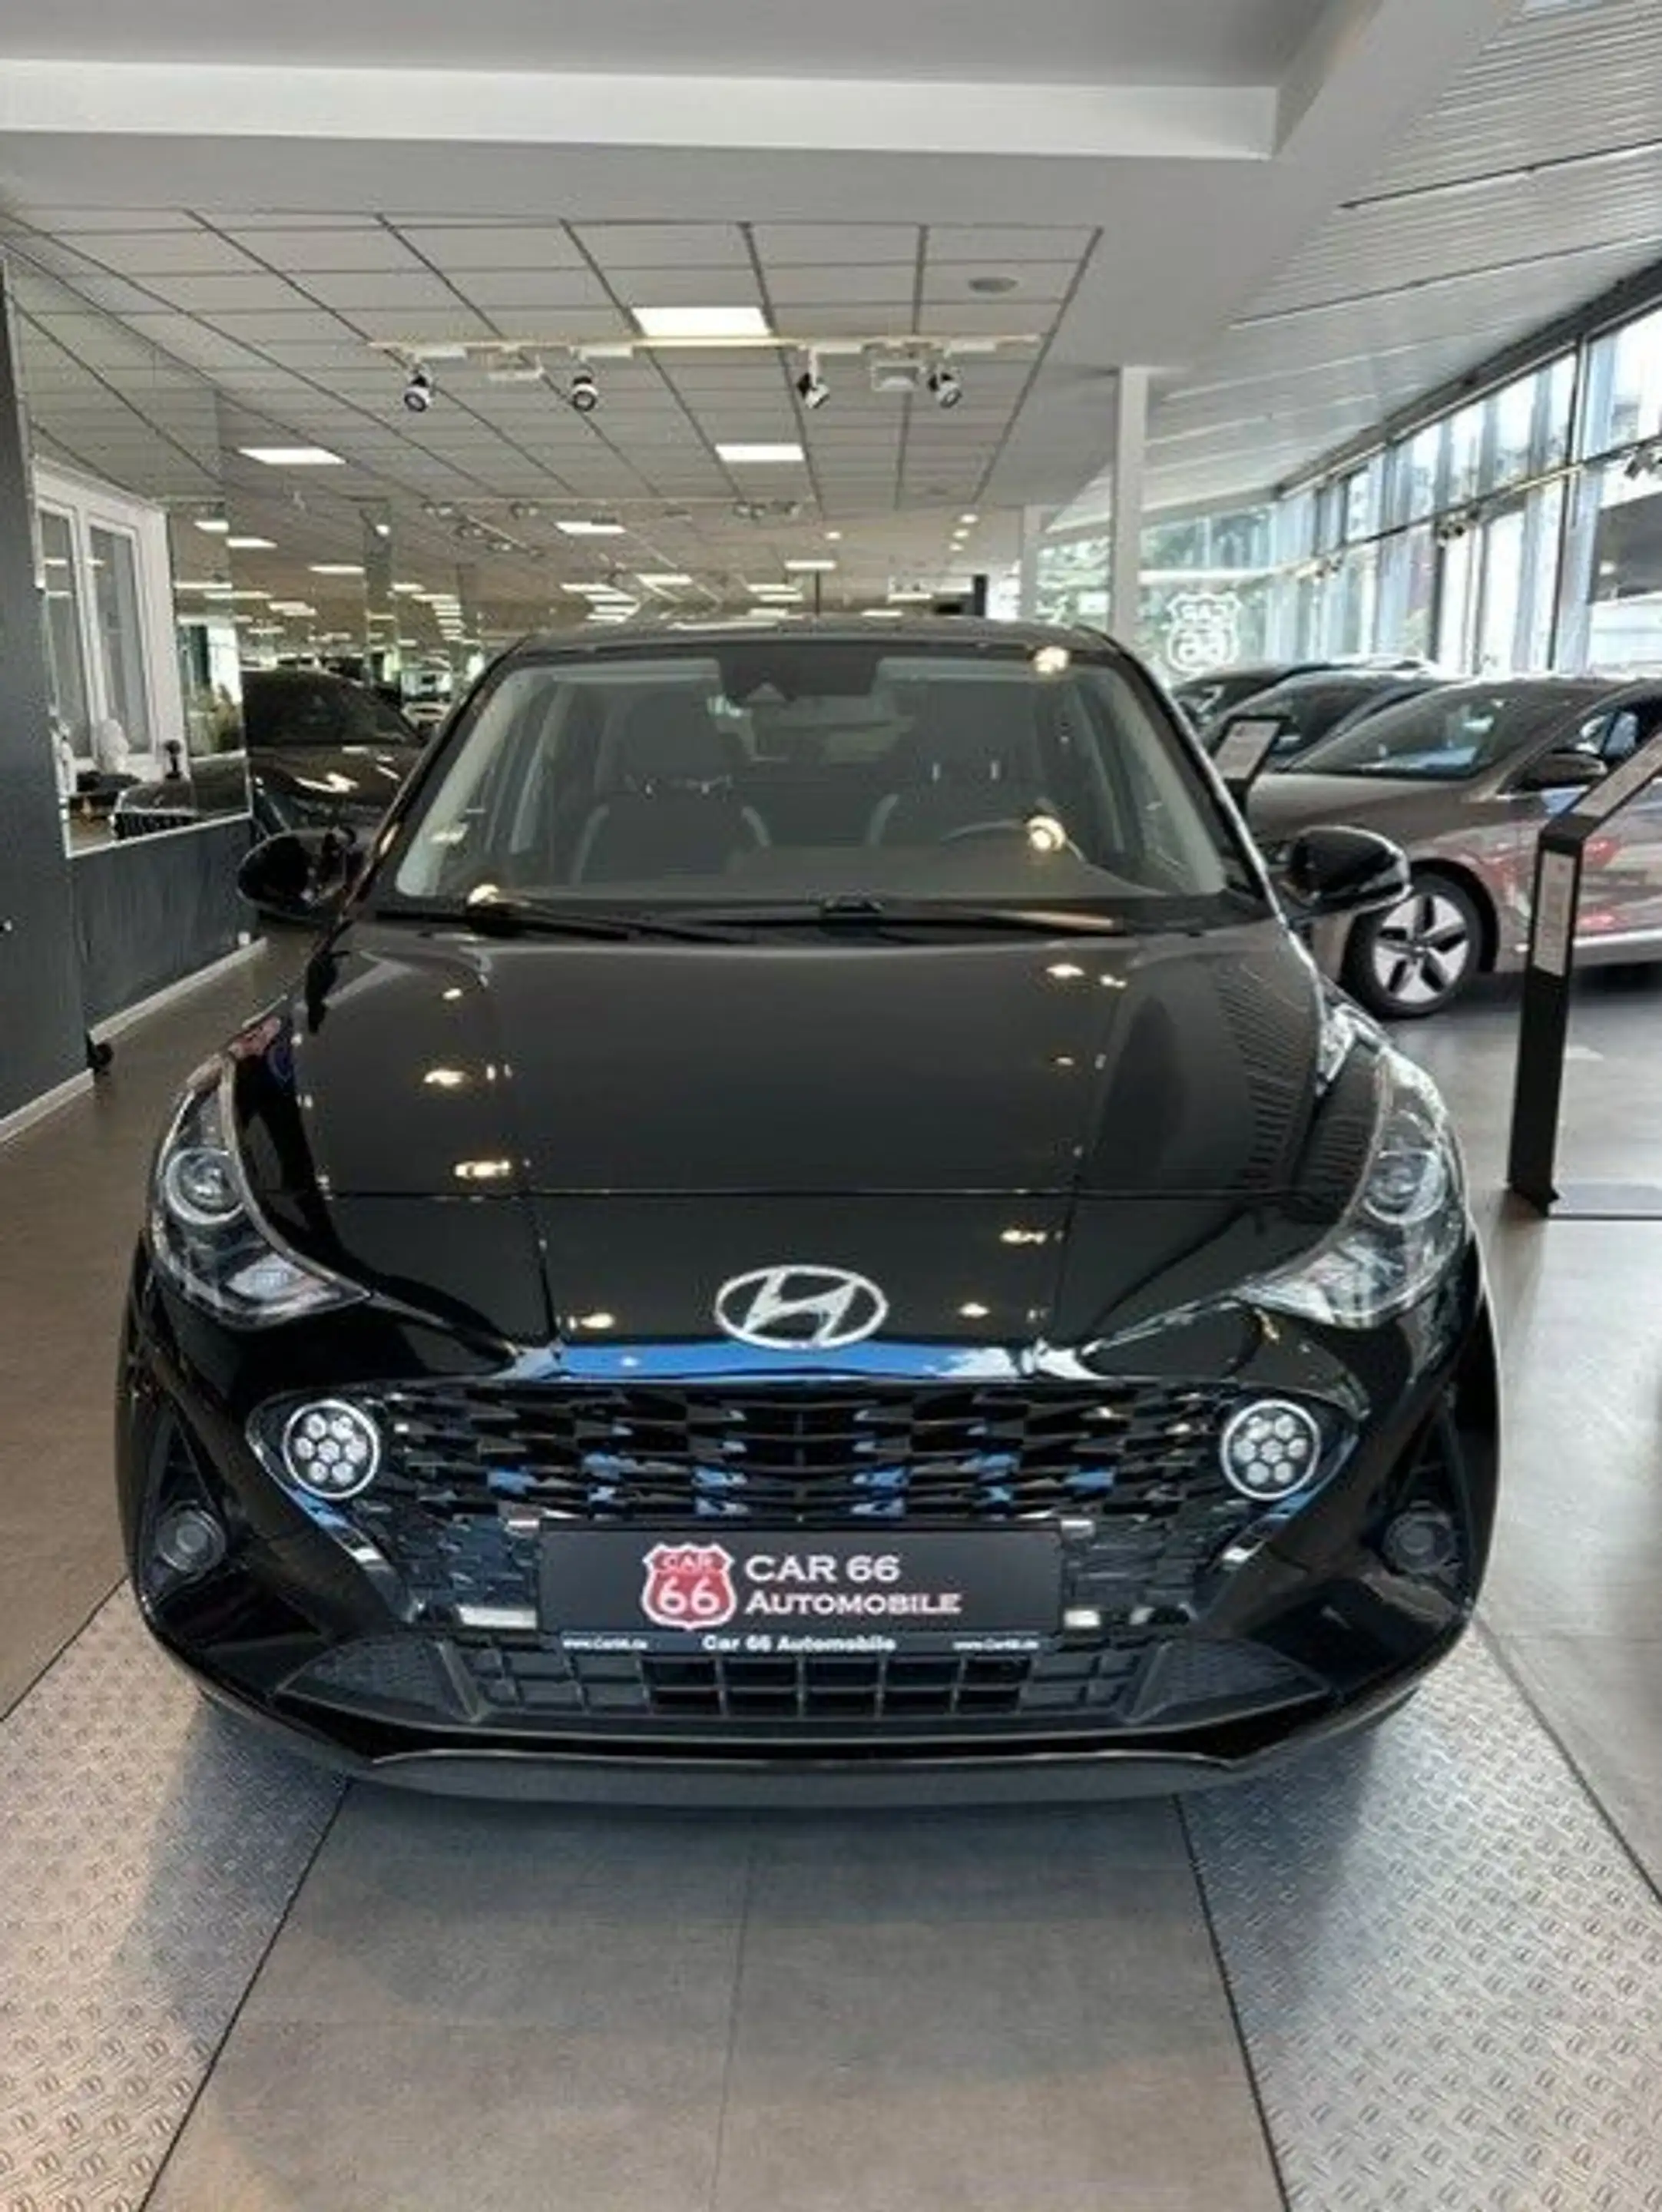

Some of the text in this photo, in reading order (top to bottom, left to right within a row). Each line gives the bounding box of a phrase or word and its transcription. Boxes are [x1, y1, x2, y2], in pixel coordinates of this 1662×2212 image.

[661, 1553, 717, 1571] CAR
[745, 1555, 901, 1582] CAR 66
[660, 1575, 720, 1614] 66
[745, 1591, 962, 1614] AUTOMOBILE
[702, 1634, 897, 1651] Car 66 Automobile
